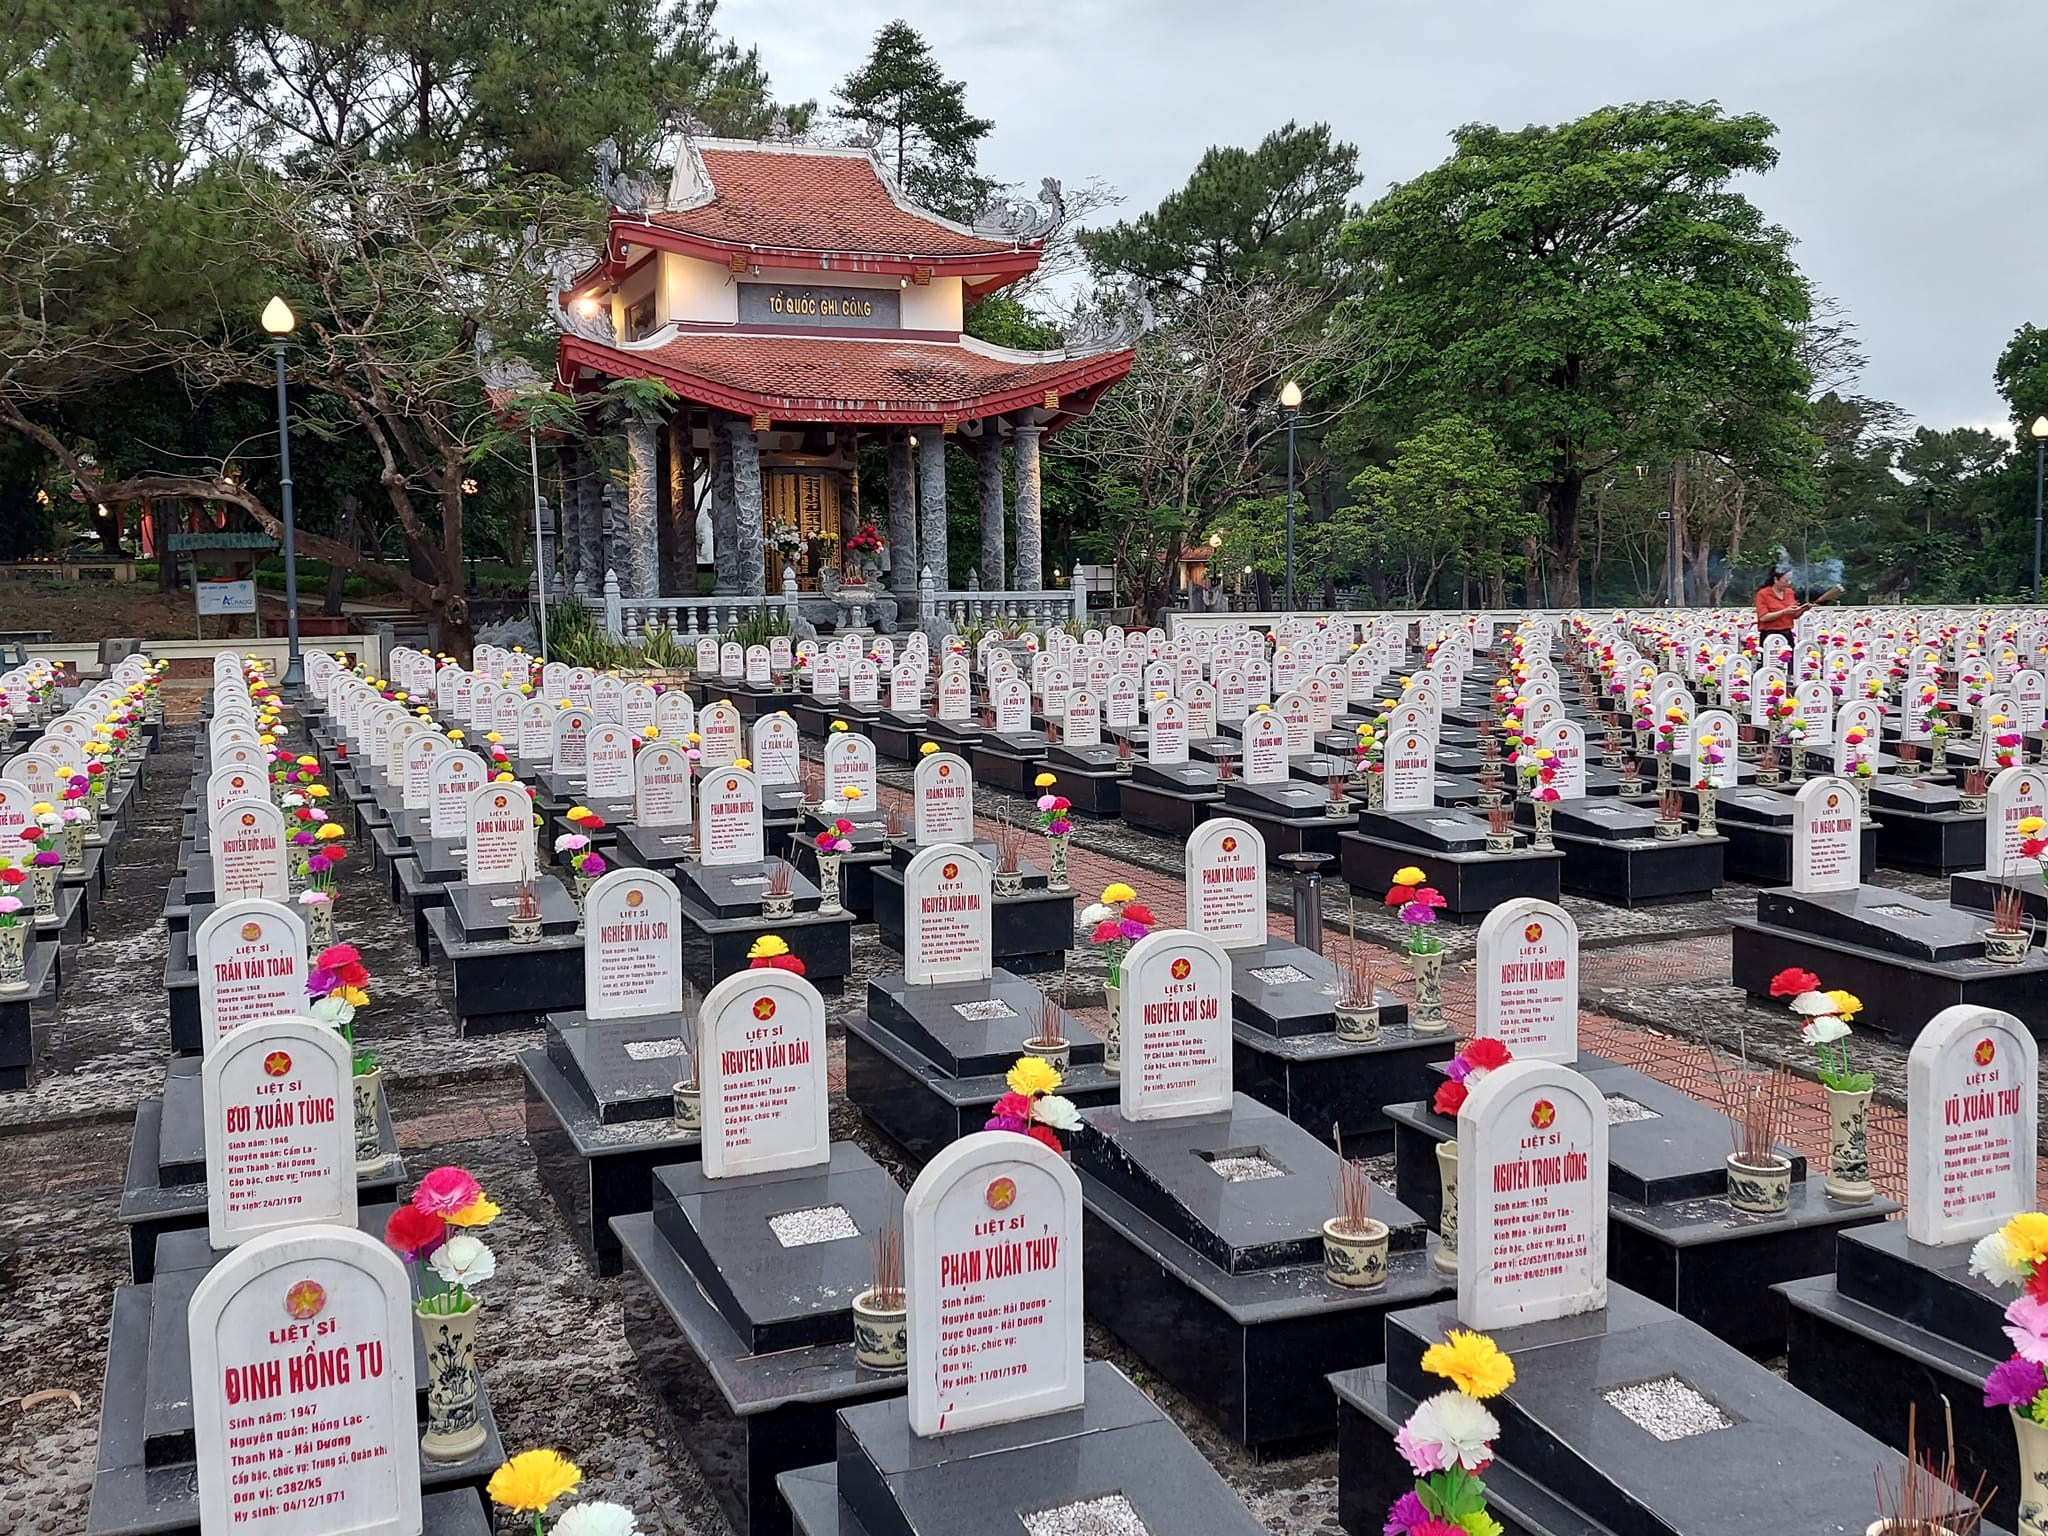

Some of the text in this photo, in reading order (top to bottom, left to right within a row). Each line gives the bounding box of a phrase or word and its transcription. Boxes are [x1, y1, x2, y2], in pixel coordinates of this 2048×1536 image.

[770, 290, 871, 317] TỔ QUỐC GHI CÔNG
[236, 944, 269, 955] LIỆT SĨ
[244, 957, 264, 979] VĂN
[1165, 982, 1196, 994] LIỆT SĨ
[746, 1025, 783, 1040] LIỆT SĨ
[722, 1037, 809, 1076] NGUYỄN VĂN DÂN
[257, 1080, 302, 1095] LIỆT SĨ
[1967, 1070, 1999, 1087] LIỆT SĨ
[255, 1098, 294, 1131] XUÂN
[1963, 1089, 1994, 1123] XUÂN
[228, 1141, 246, 1151] Sinh
[1521, 1132, 1561, 1149] LIỆT SĨ
[1494, 1150, 1530, 1193] NGUYỄN
[1533, 1156, 1561, 1193] TRỌNG
[975, 1215, 1025, 1236] LIỆT SĨ
[941, 1250, 981, 1292] PHẠM
[985, 1240, 1022, 1280] XUÂN
[942, 1297, 961, 1309] Sinh
[269, 1317, 336, 1344] LIỆT SĨ
[225, 1360, 282, 1405] ĐINH
[289, 1340, 350, 1394] HỒNG
[943, 1379, 953, 1389] Hy
[229, 1417, 255, 1430] Sinh
[291, 1404, 317, 1418] 1947
[230, 1432, 273, 1449] Nguyên
[231, 1453, 265, 1467] Thanh
[294, 1441, 313, 1457] Hải
[317, 1435, 351, 1451] Dương
[312, 1456, 336, 1471] Trung
[259, 1486, 273, 1500] vị:
[276, 1477, 322, 1495] c382/k5
[234, 1490, 345, 1523] Hy sinh: 04/12/1971
